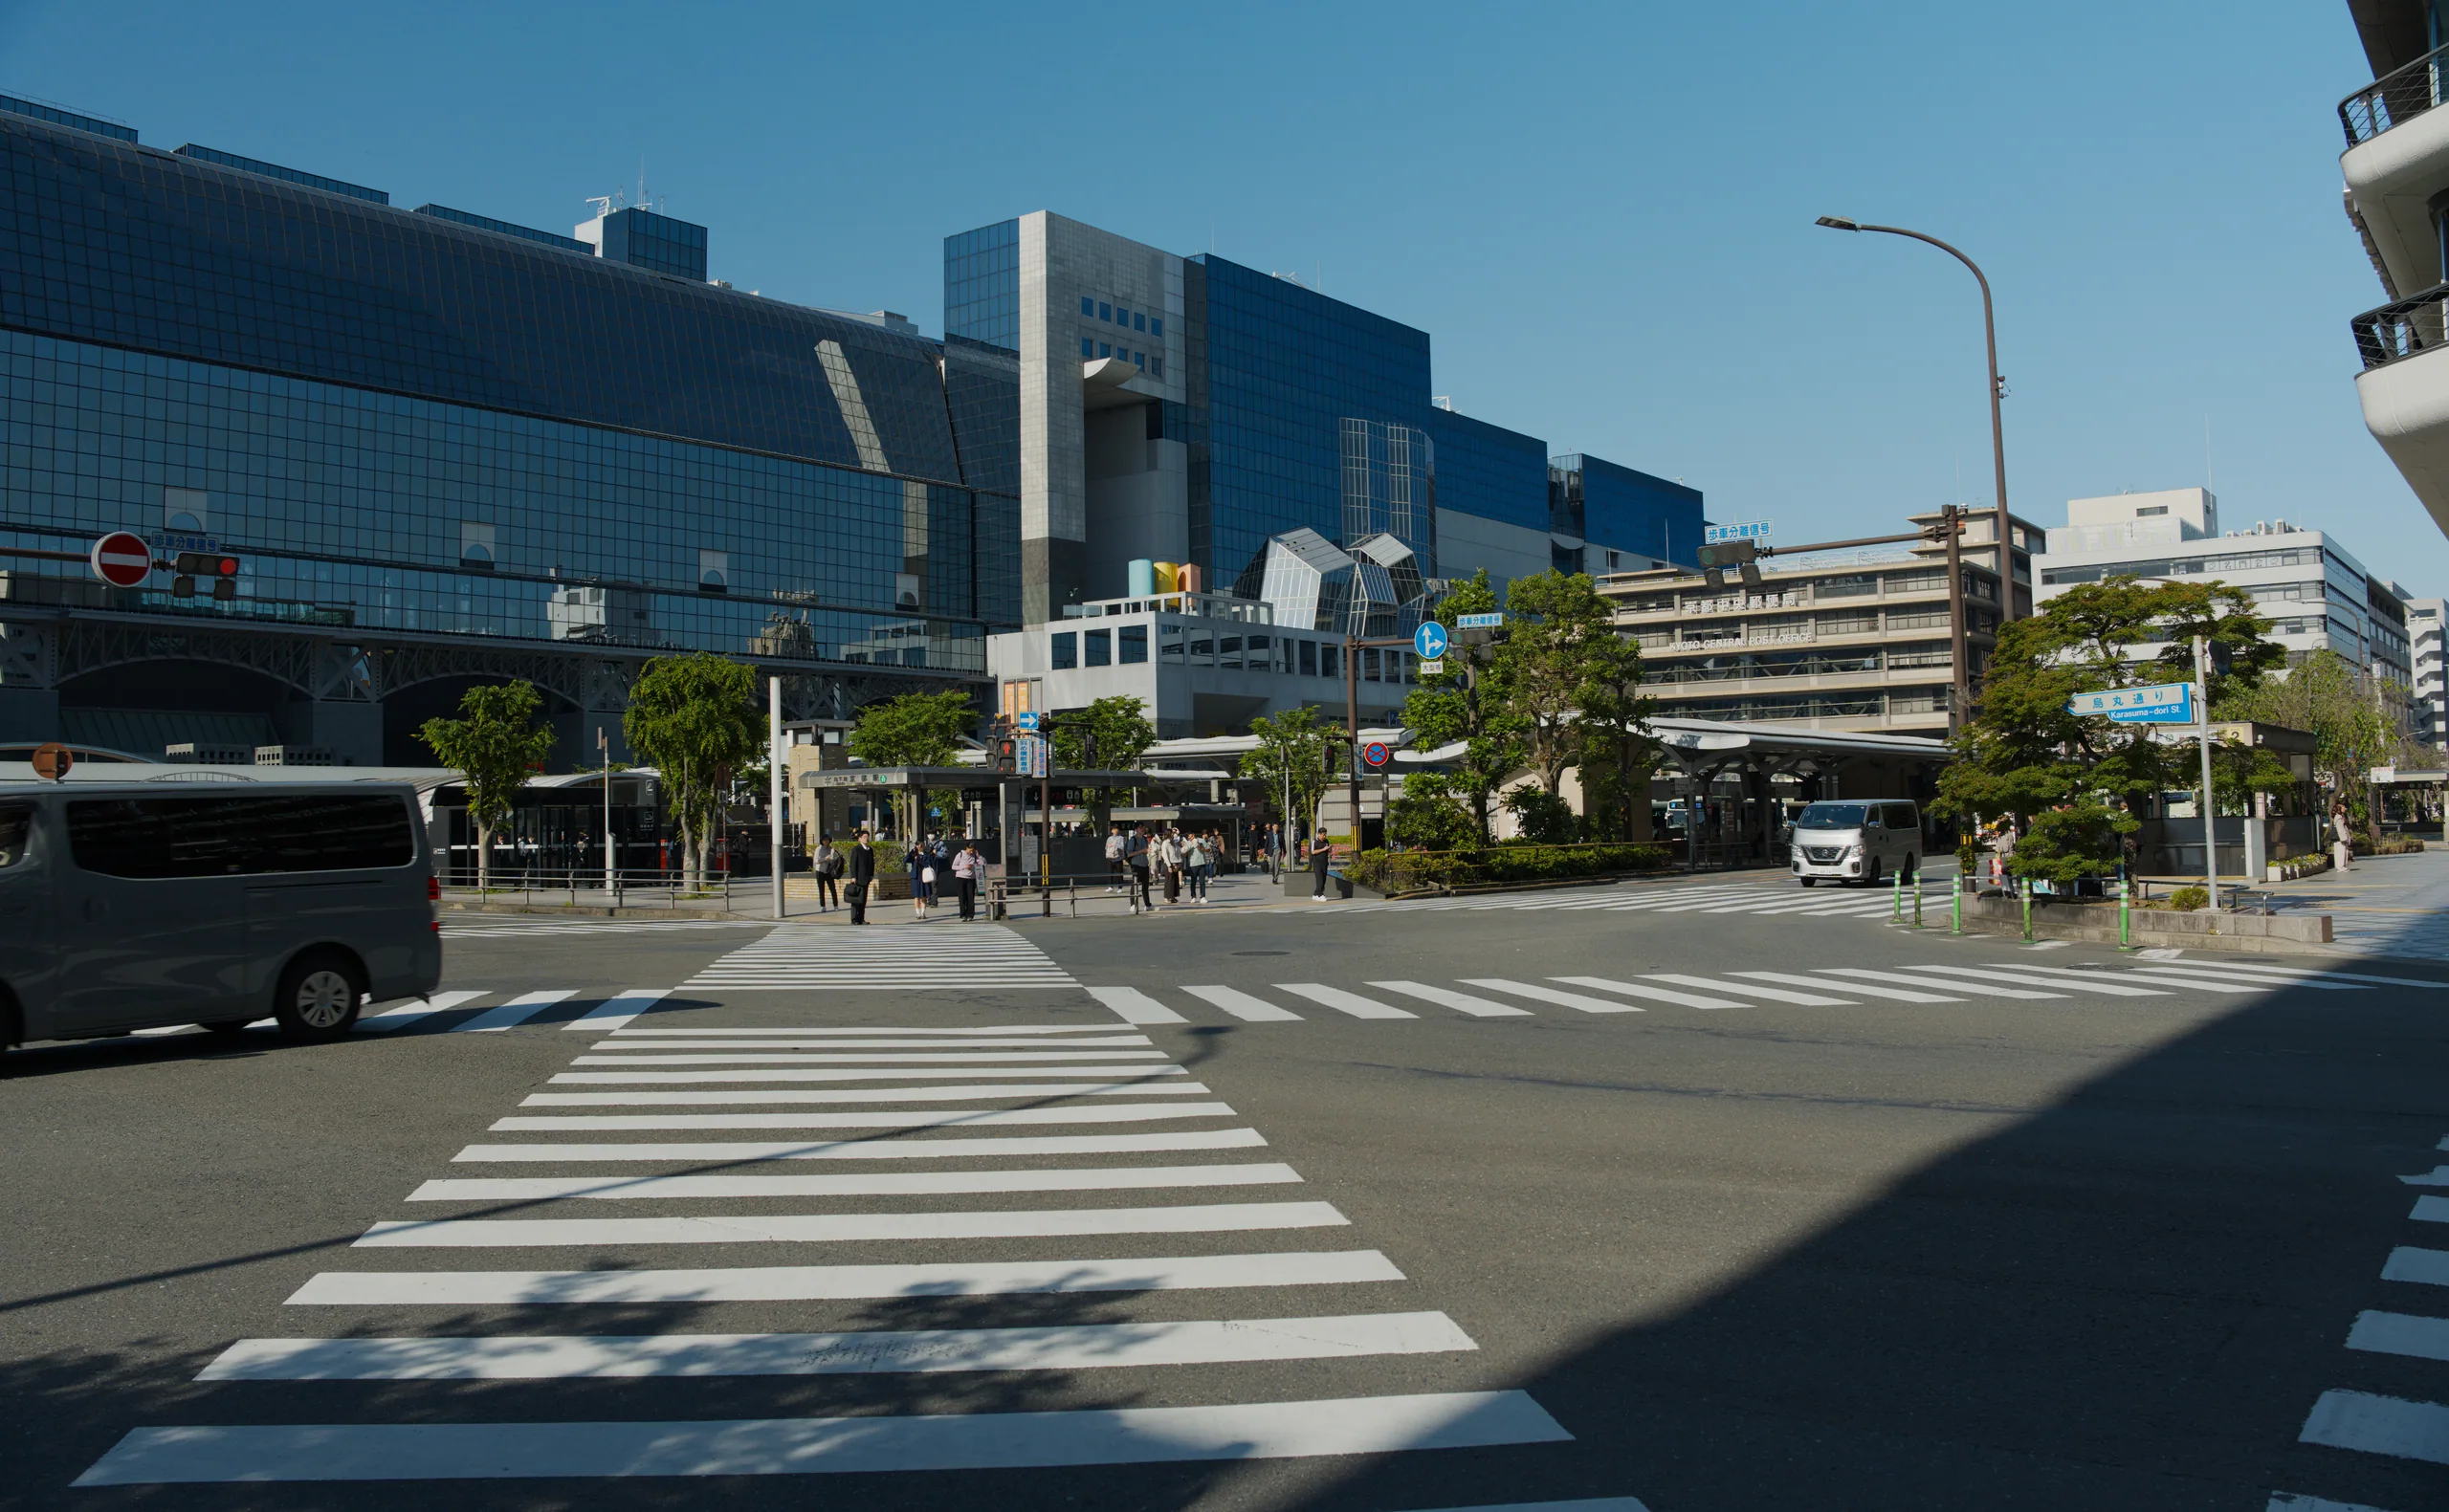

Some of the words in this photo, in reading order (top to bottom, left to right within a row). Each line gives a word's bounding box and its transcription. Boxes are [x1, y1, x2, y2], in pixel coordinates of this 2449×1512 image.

[1708, 522, 1770, 540] 歩車分離信号
[1684, 593, 1797, 614] 京都中央郵便局
[1459, 614, 1501, 626] 歩車分離信号
[1669, 640, 1700, 652] KYOTO
[1704, 637, 1747, 650] CENTRAL
[1749, 635, 1775, 646] POST
[1777, 632, 1813, 644] OFFICE
[2171, 705, 2182, 713] St.
